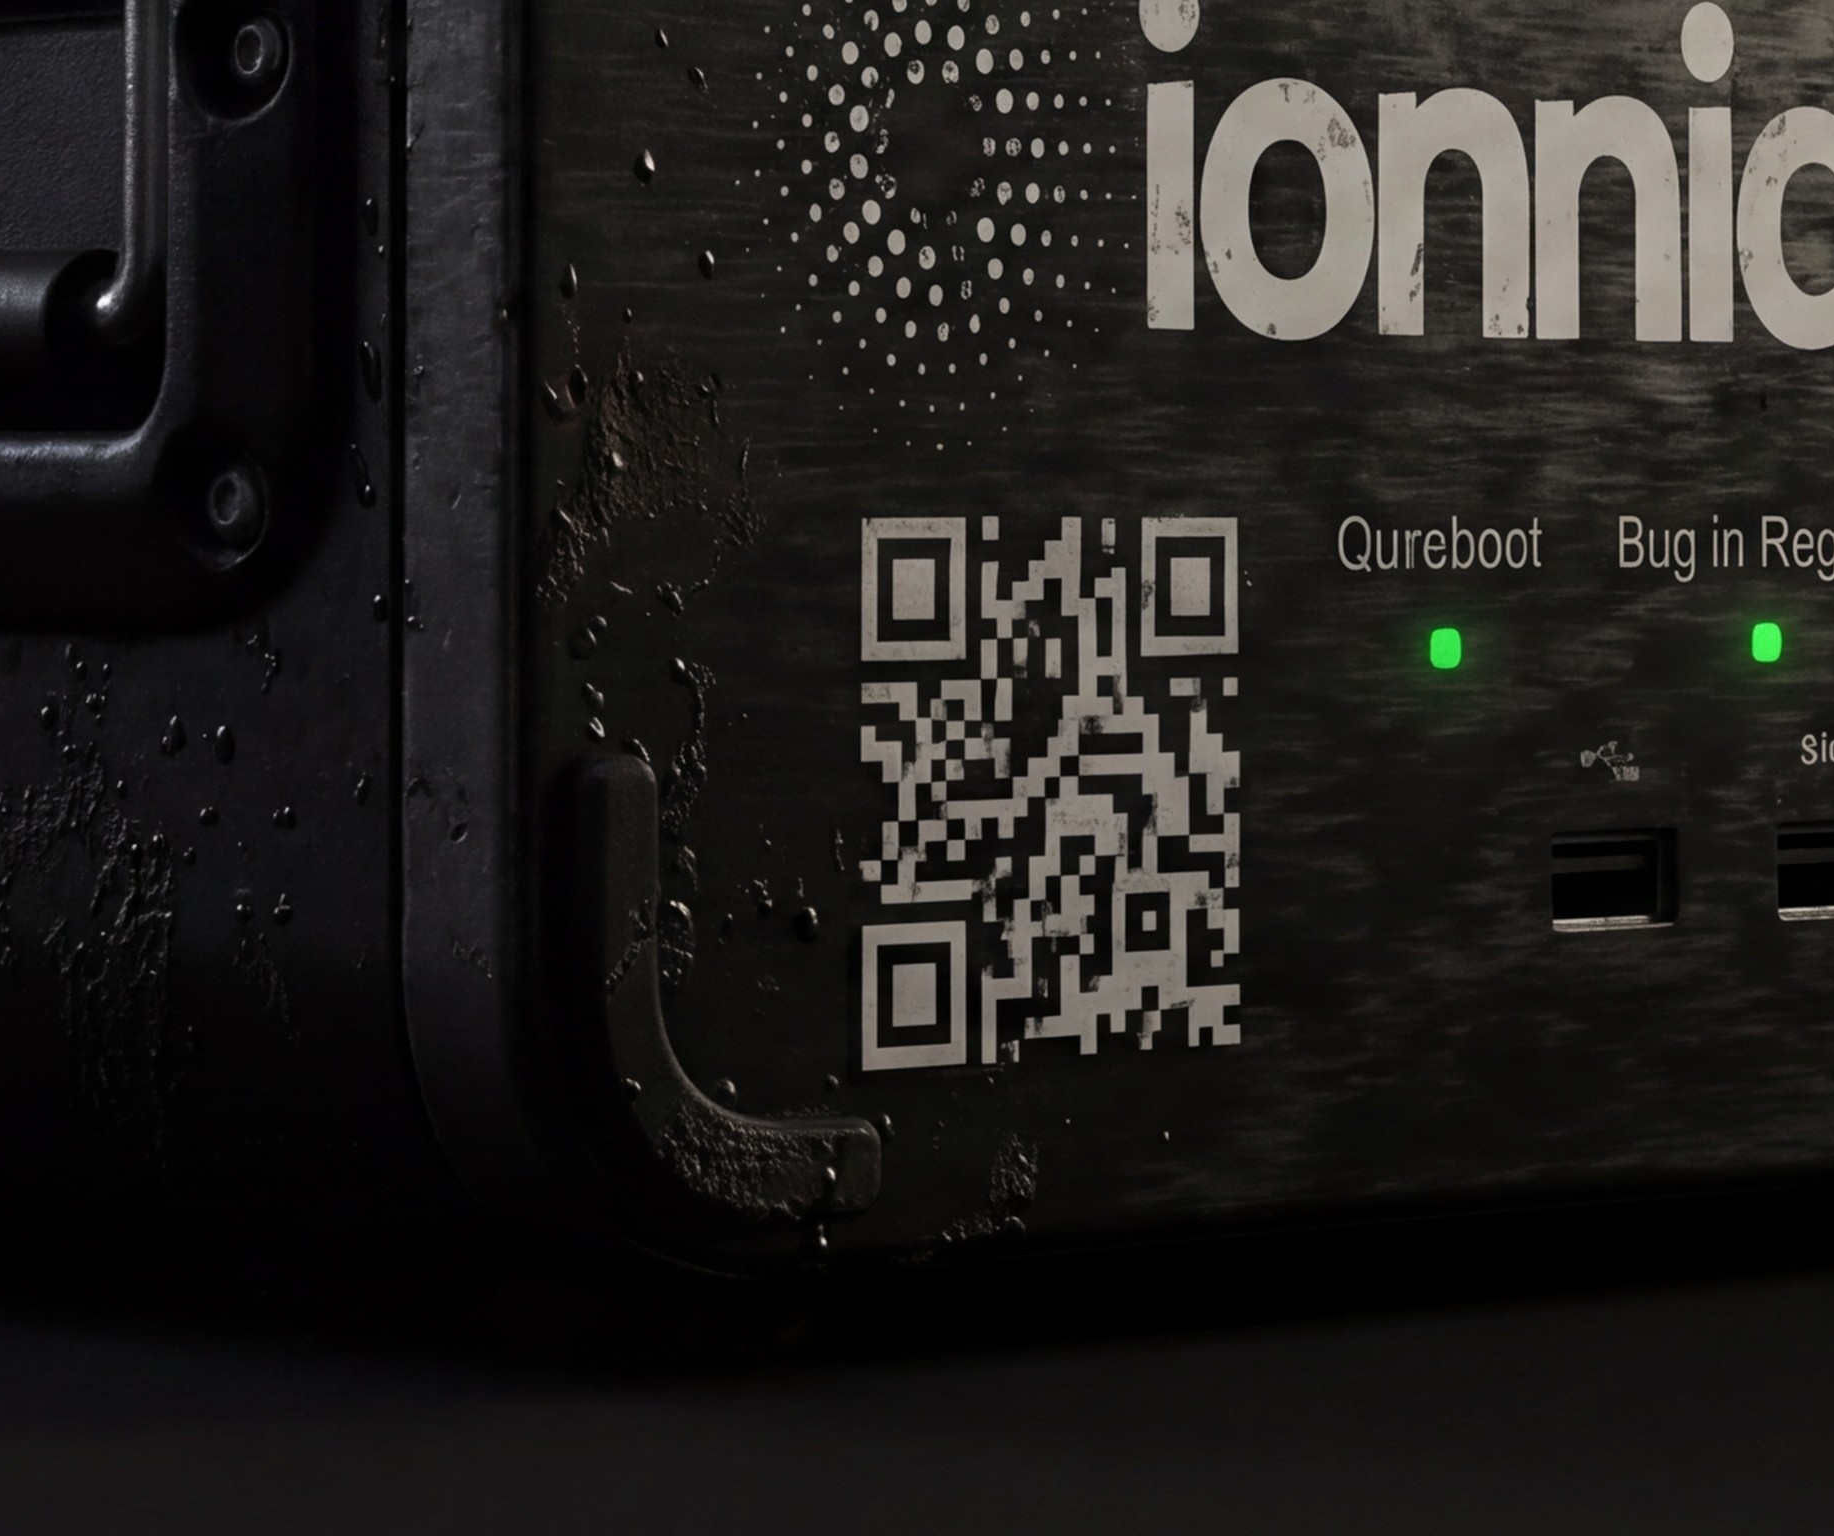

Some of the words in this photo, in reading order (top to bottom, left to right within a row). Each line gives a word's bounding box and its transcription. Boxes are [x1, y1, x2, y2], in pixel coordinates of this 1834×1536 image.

[1337, 514, 1543, 572] Qureboot
[1619, 514, 1696, 583] Bug
[1712, 514, 1745, 568] in
